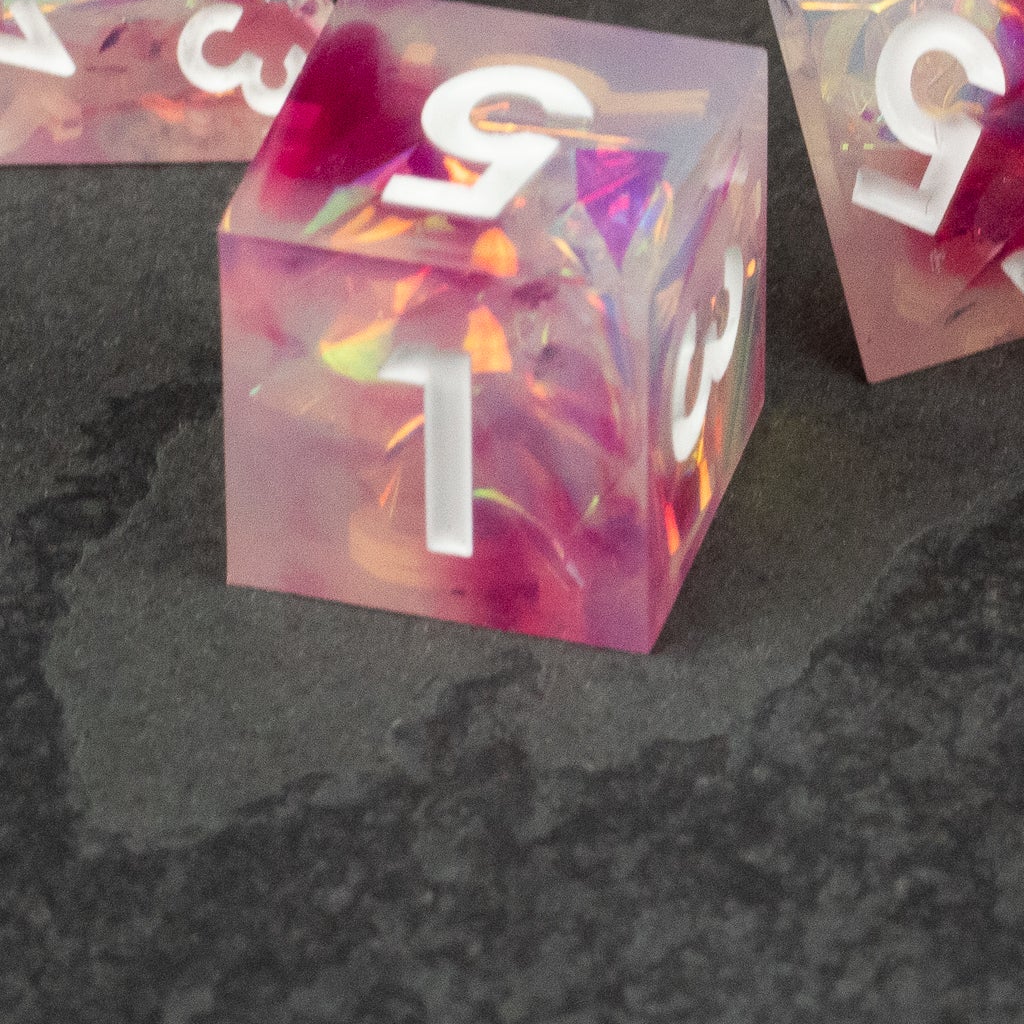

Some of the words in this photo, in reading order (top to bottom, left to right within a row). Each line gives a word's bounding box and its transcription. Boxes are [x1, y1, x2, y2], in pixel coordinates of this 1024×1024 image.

[177, 2, 306, 116] 3
[381, 65, 594, 219] 5
[851, 12, 1006, 236] 5
[379, 346, 473, 558] 1
[672, 248, 743, 463] 3
